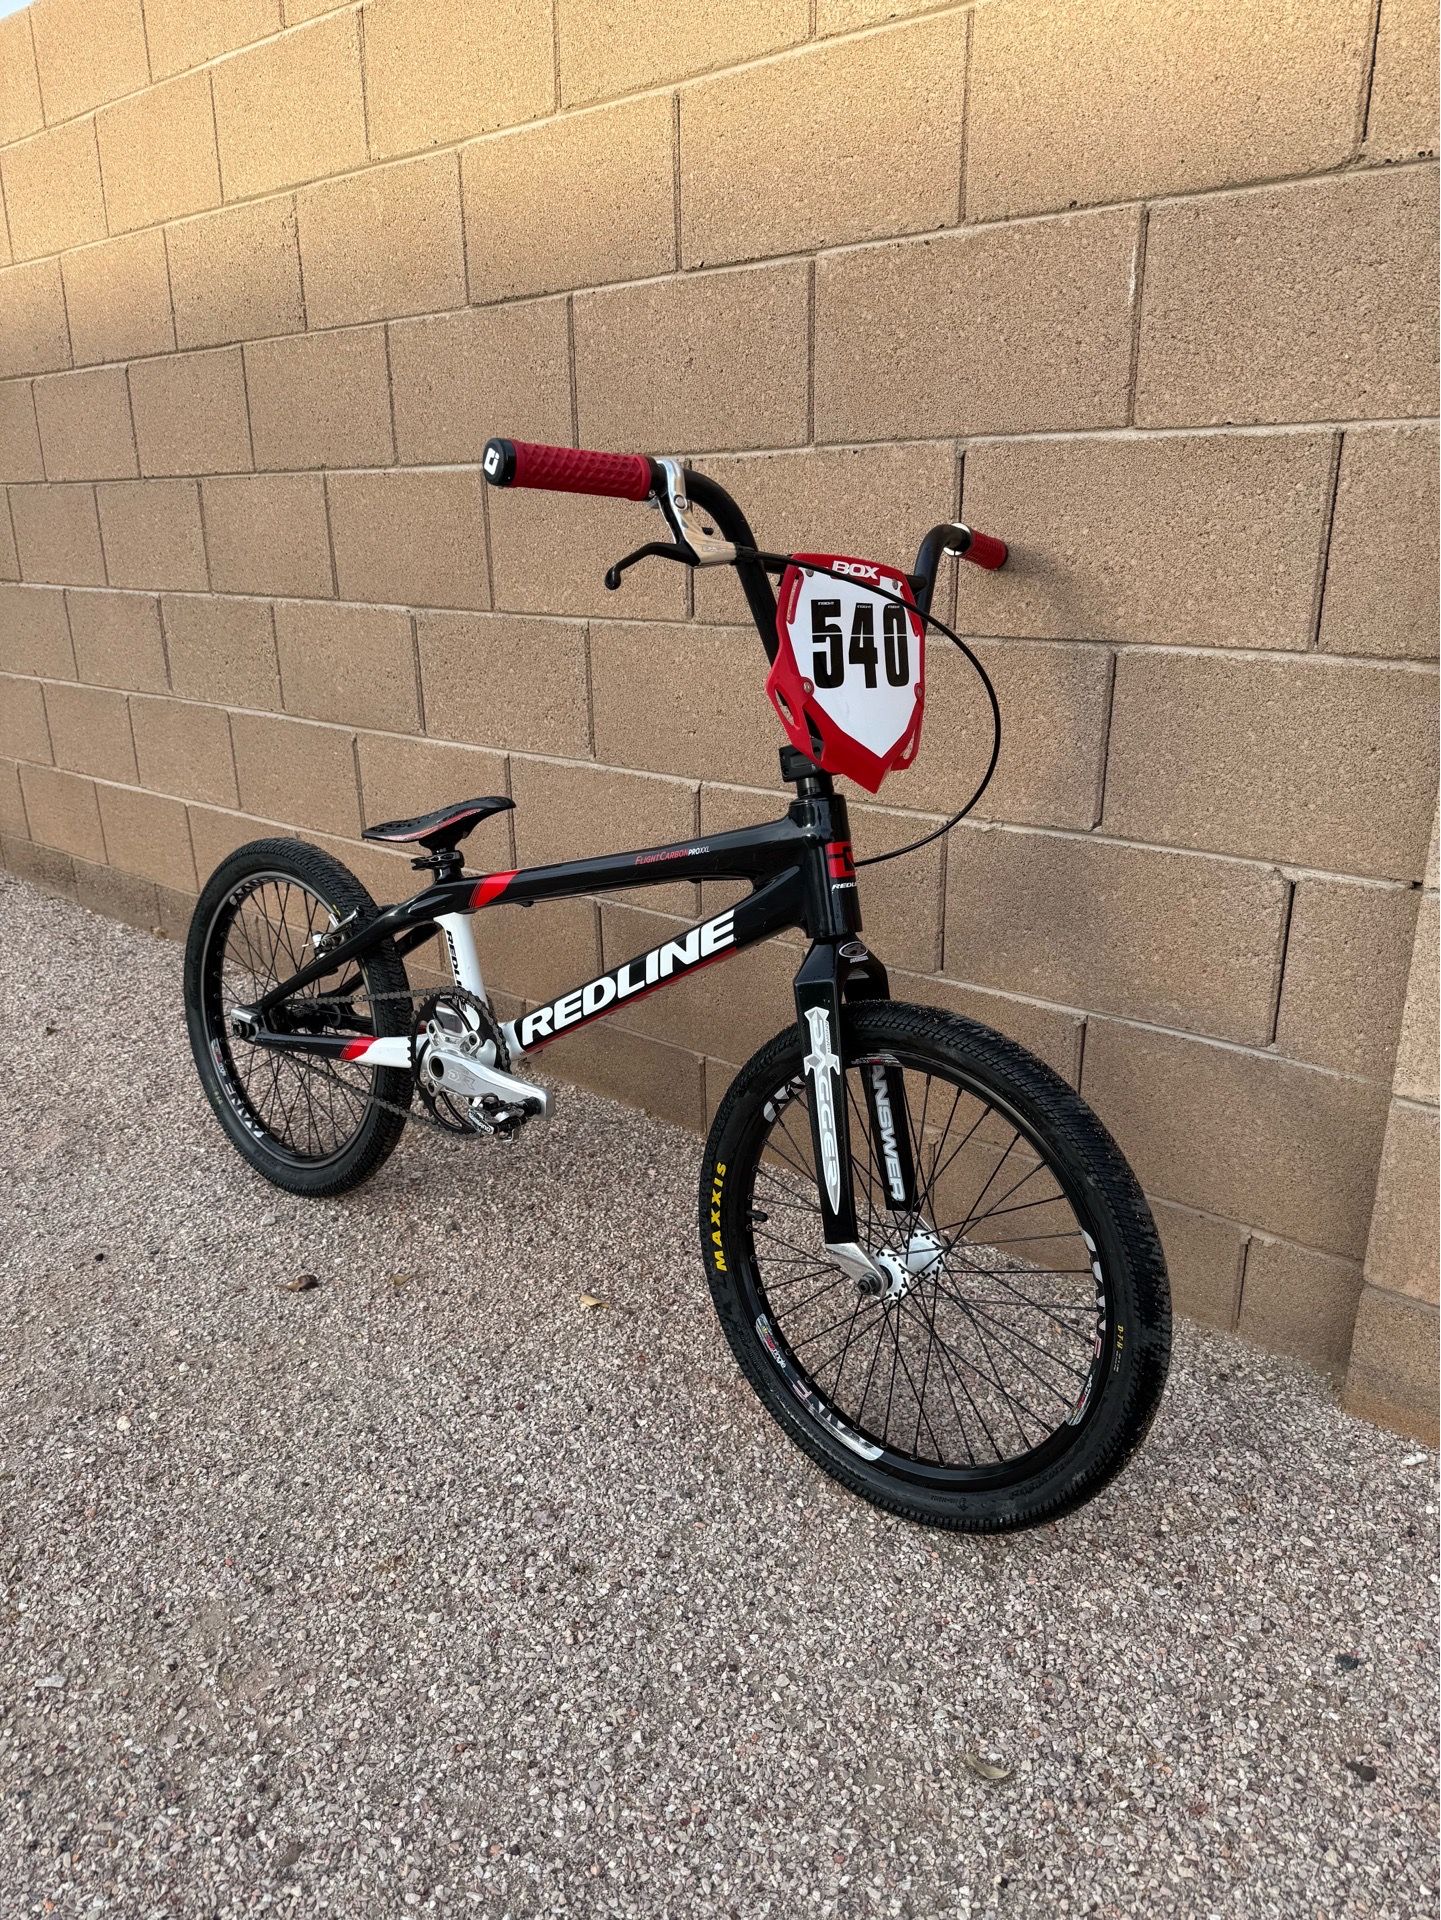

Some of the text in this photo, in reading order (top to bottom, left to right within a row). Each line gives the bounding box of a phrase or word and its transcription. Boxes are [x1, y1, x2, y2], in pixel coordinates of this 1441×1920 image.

[832, 560, 879, 579] BOX
[811, 599, 909, 688] 540
[522, 910, 735, 1046] REDLINE
[872, 1065, 906, 1202] ANSWER
[711, 1161, 727, 1272] MAXXIS
